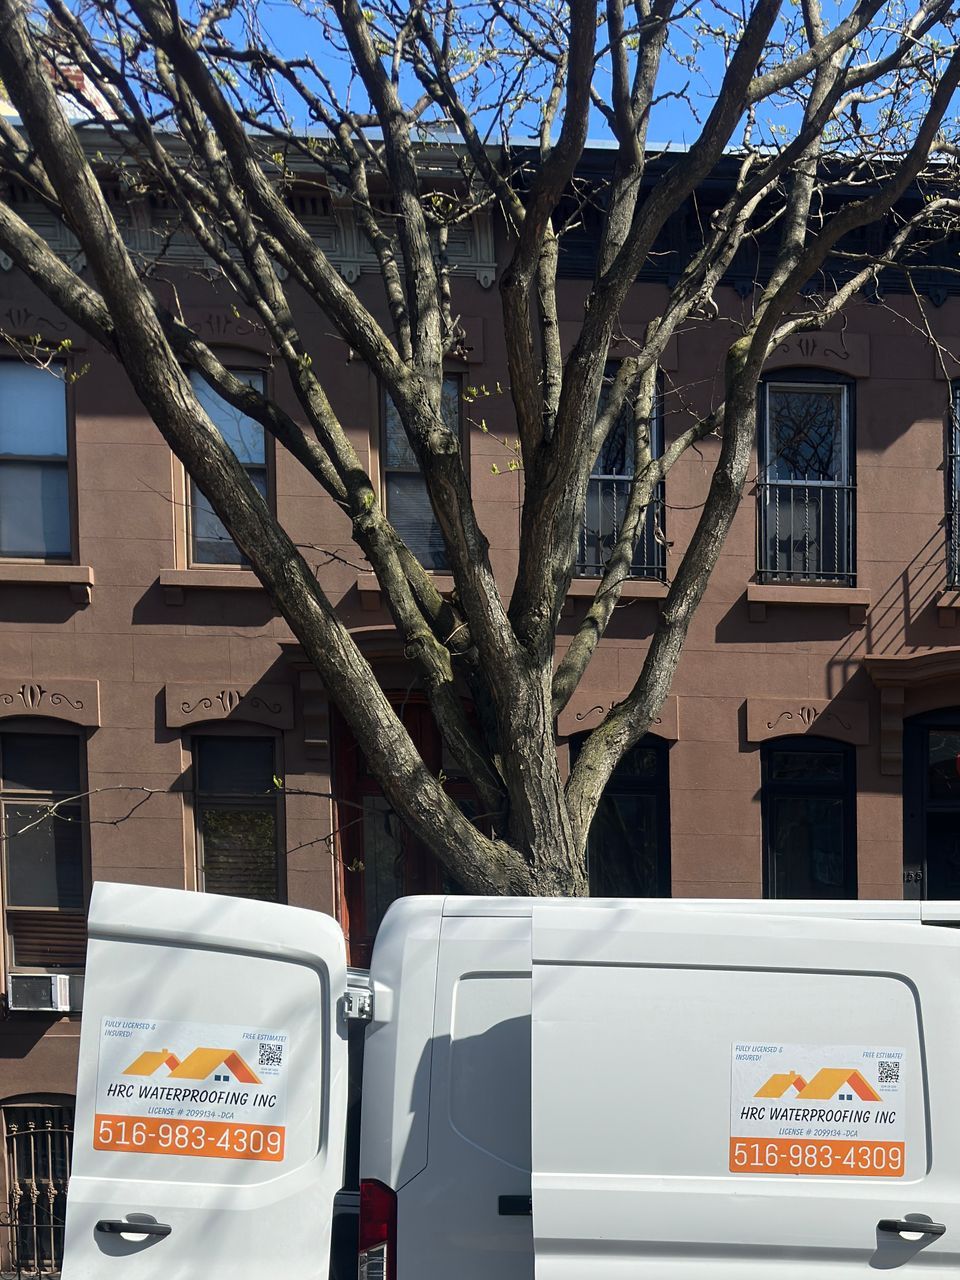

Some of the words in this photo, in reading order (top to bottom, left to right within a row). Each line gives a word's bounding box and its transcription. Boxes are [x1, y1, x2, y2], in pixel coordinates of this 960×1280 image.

[104, 1020, 121, 1028] FULLY
[122, 1021, 150, 1030] LICENSED
[104, 1030, 133, 1038] INSURED!
[242, 1032, 256, 1040] FREE
[256, 1033, 287, 1042] ESTIMATE!
[862, 1051, 875, 1059] FREE
[875, 1052, 903, 1060] ESTIMATE!
[107, 1083, 134, 1098] HRC
[139, 1085, 249, 1106] WATERPROOFING
[252, 1093, 277, 1108] INC
[147, 1107, 175, 1116] LICENSE
[740, 1106, 766, 1120] HRC
[769, 1107, 871, 1124] WATERPROOFING
[874, 1110, 896, 1124] INC
[778, 1128, 804, 1136] LICENSE
[98, 1120, 281, 1155] 516-983-4309
[734, 1143, 901, 1169] 516-983-4309
